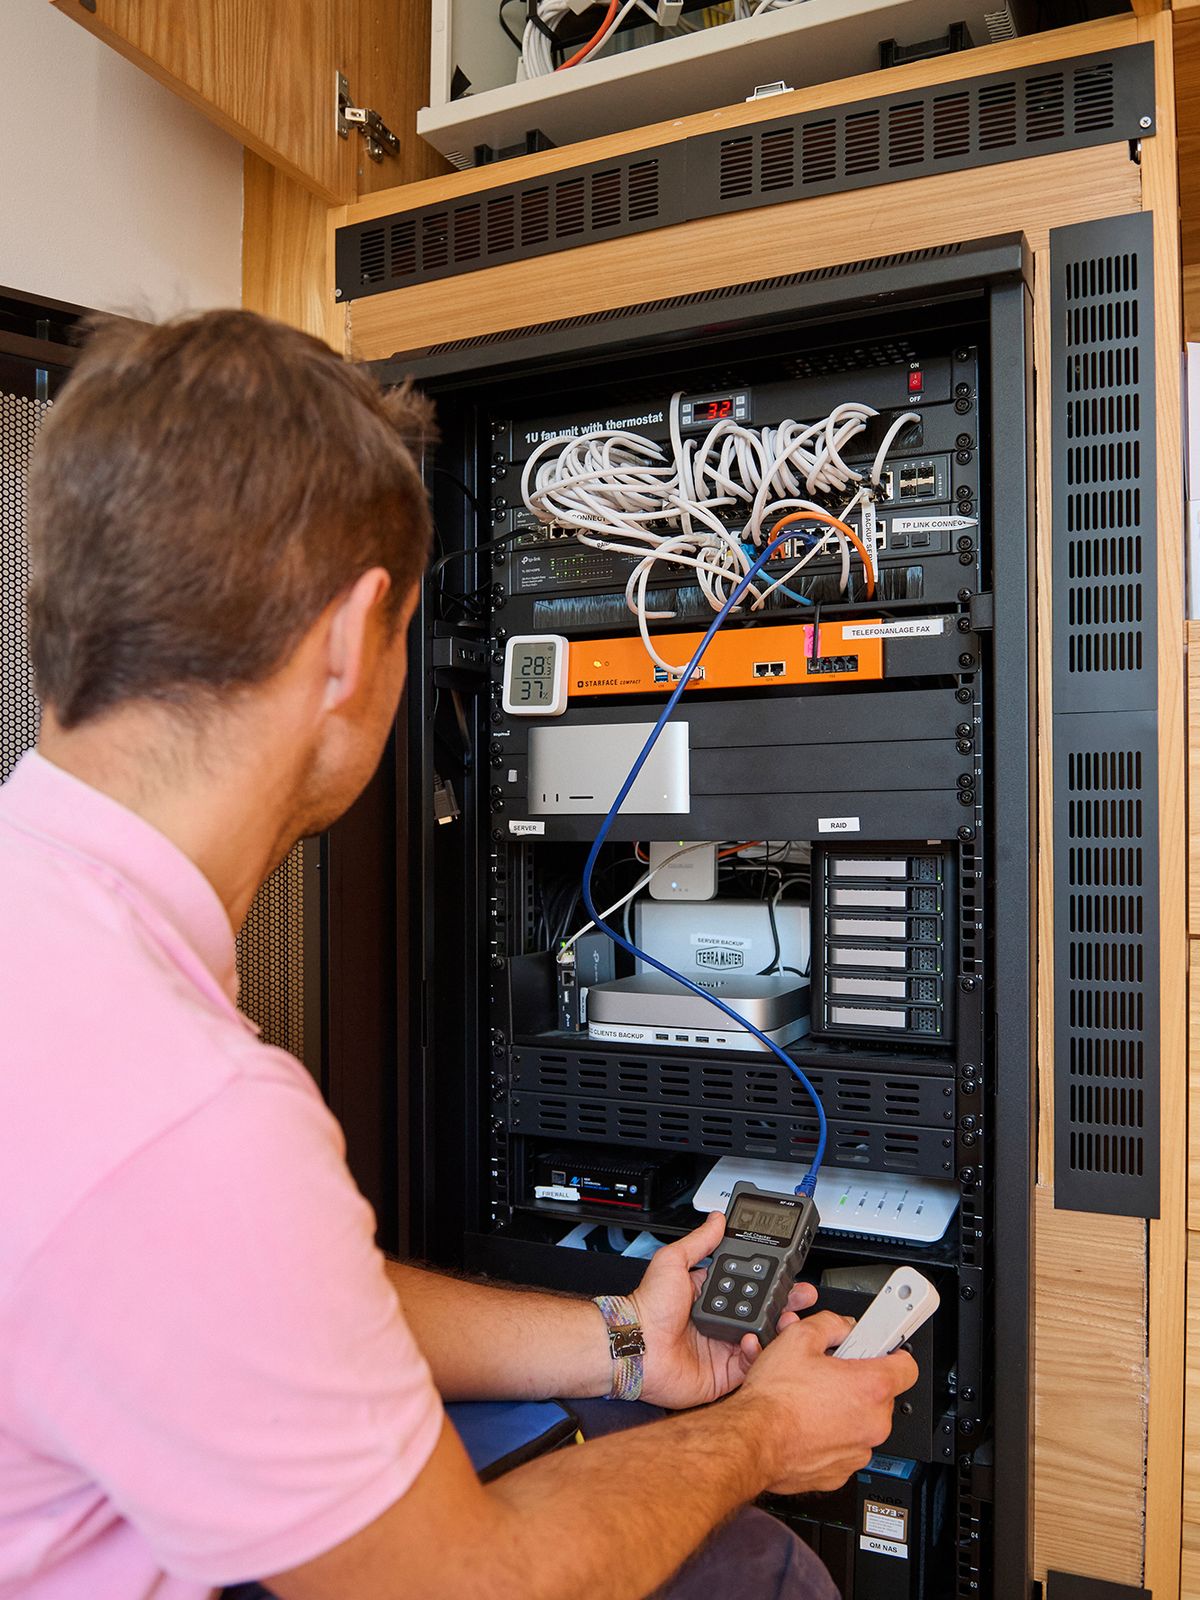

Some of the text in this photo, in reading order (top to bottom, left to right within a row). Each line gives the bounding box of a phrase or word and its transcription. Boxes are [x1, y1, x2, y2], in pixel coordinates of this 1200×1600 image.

[706, 400, 731, 420] 32
[525, 411, 664, 444] 1U fan unit with thermostat
[852, 625, 931, 636] TELEFONANLAGE FAX
[585, 679, 618, 687] STARFACE
[697, 937, 744, 947] SERVER BACKUP
[594, 1029, 618, 1038] CLIENTS
[618, 1031, 645, 1040] BACKUP
[542, 1190, 569, 1198] FIREWALL
[739, 1305, 748, 1313] OK
[869, 1541, 898, 1553] QM NAS
[970, 1581, 978, 1589] 03
